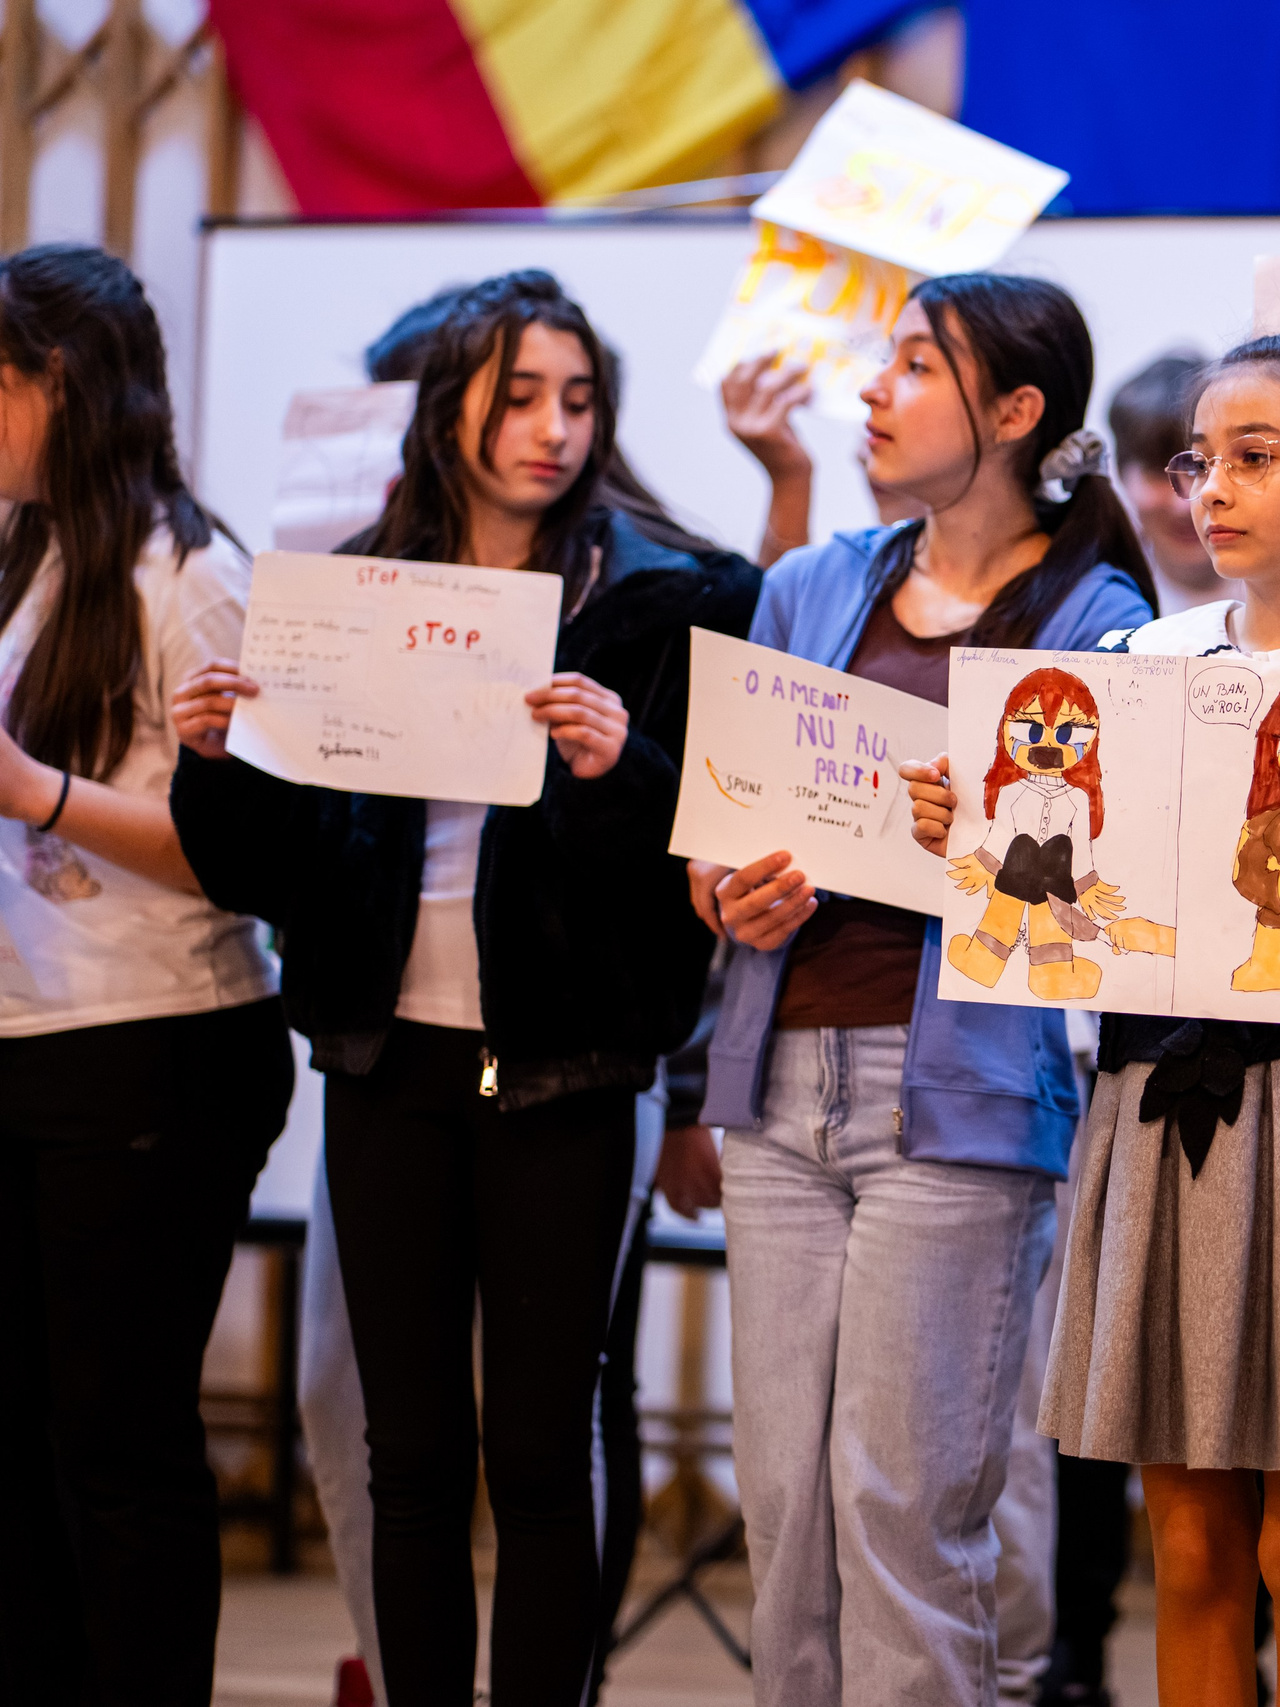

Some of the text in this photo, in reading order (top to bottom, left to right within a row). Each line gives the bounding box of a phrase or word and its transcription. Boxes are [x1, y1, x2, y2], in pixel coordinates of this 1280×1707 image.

[357, 566, 399, 586] STOP
[406, 620, 481, 651] STOP
[1192, 682, 1247, 699] UN BAN,
[1218, 697, 1249, 714] ROG!
[796, 712, 887, 762] NU AU
[726, 774, 763, 796] SPUNE
